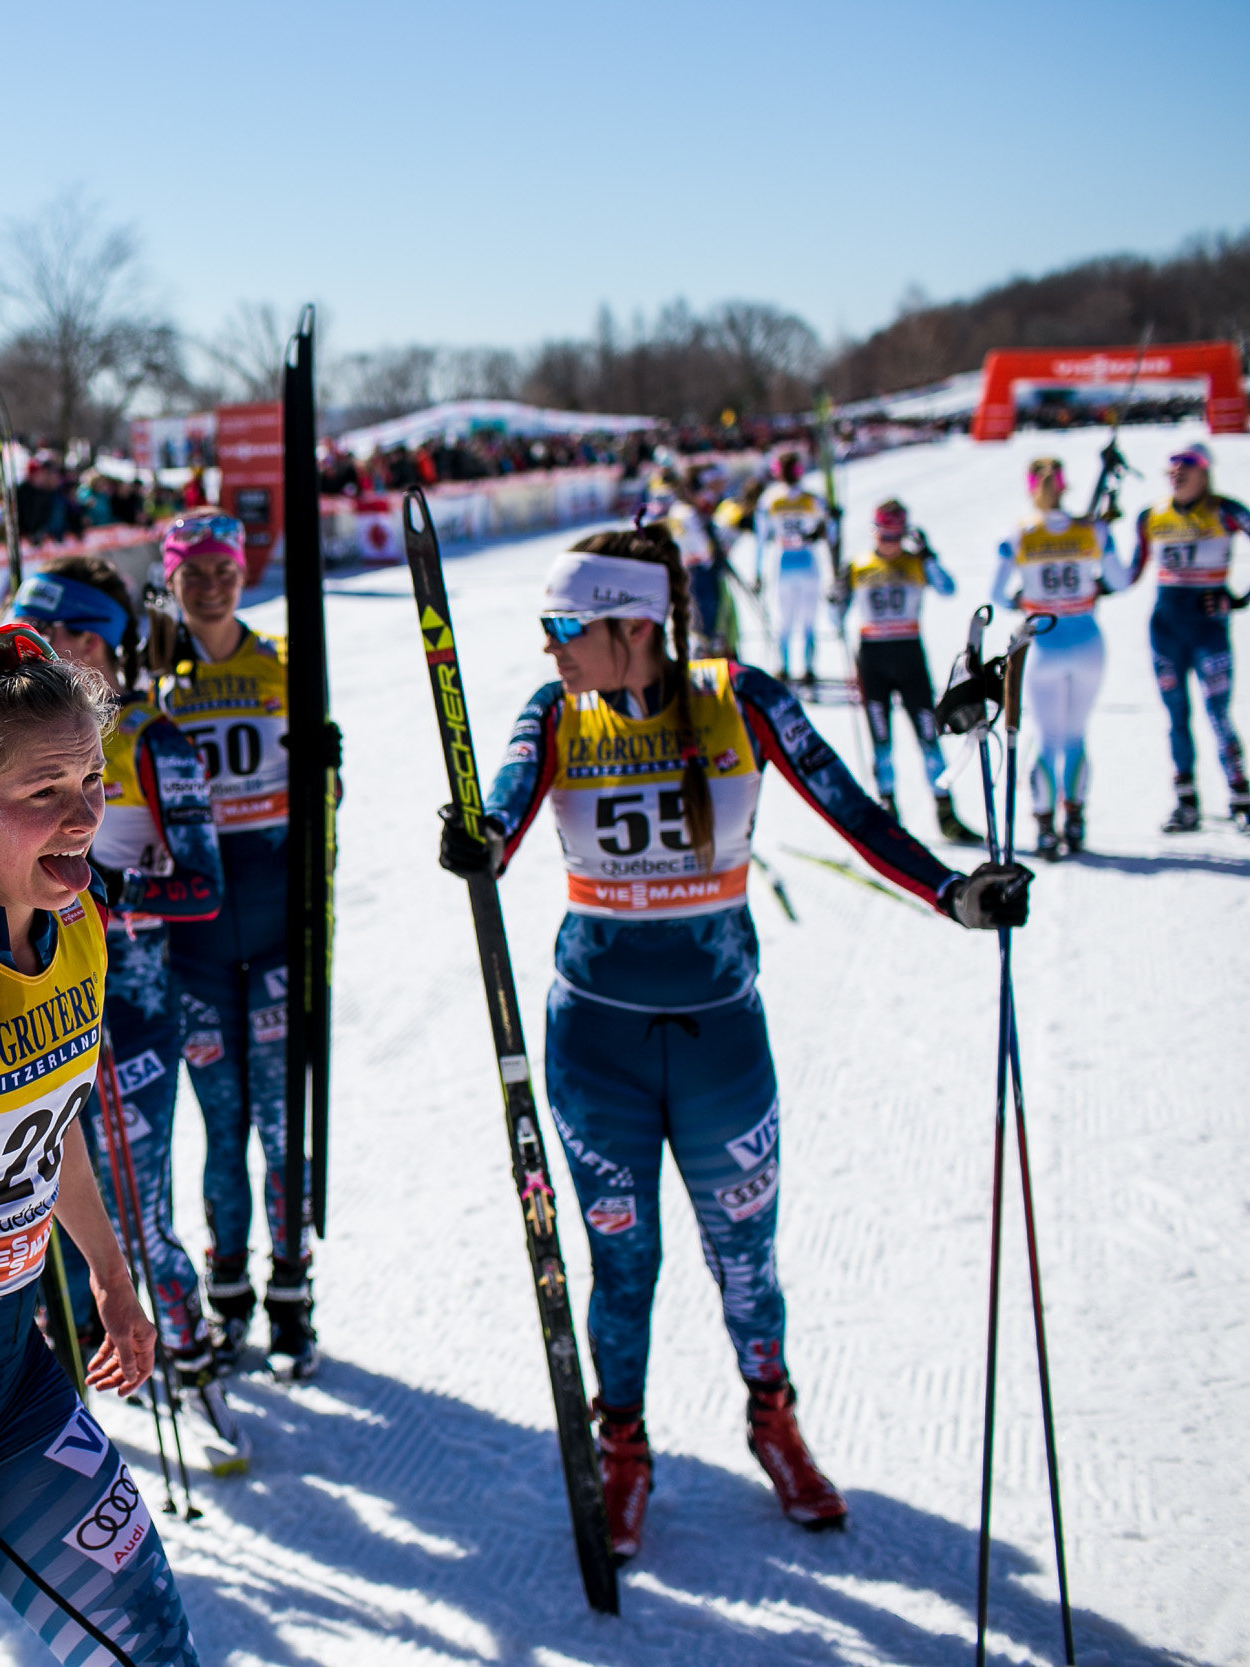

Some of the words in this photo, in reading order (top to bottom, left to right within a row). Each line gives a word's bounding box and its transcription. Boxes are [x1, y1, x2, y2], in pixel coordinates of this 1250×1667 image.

[184, 723, 261, 778] 50
[437, 663, 487, 845] FISCHER
[601, 858, 679, 877] Québec
[118, 1056, 160, 1091] ISA
[113, 1524, 145, 1565] Audi
